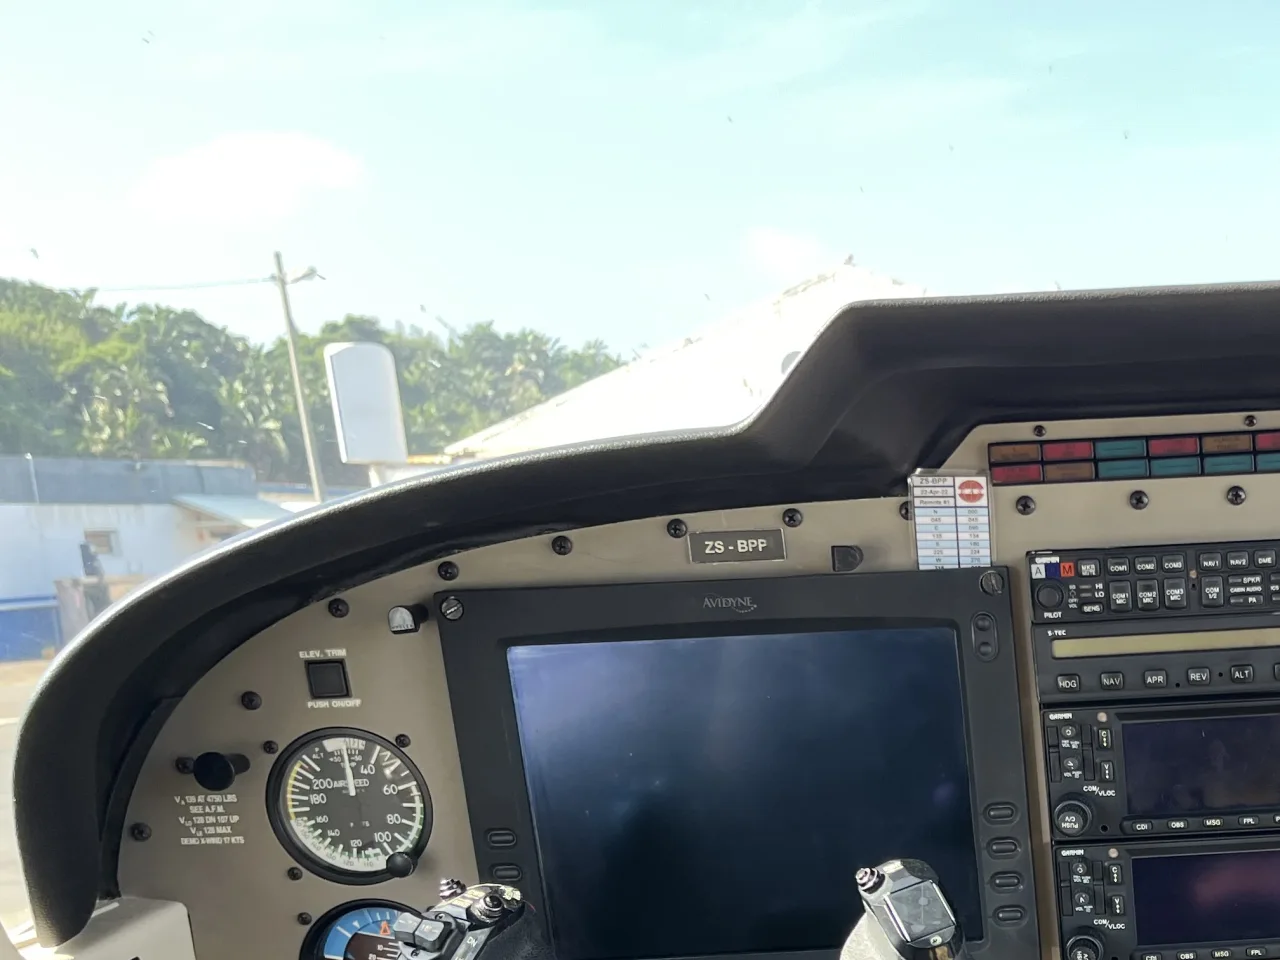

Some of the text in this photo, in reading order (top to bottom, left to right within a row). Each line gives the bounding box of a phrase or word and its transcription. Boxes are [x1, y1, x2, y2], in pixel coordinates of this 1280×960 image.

[703, 596, 755, 609] AVIDYNE
[1044, 611, 1062, 619] PILOT
[298, 648, 347, 658] ELEV. TRIM
[1190, 673, 1207, 681] REV
[1234, 670, 1249, 679] ALT
[1060, 680, 1077, 688] HDG
[1103, 677, 1120, 686] NAV
[1146, 676, 1164, 684] APR
[307, 699, 361, 709] PUSH ON/OFF
[360, 764, 376, 775] 40
[383, 784, 398, 795] 60
[310, 793, 327, 805] 180
[316, 815, 329, 824] 160
[386, 813, 401, 825] 80
[1171, 821, 1185, 829] OBS
[374, 831, 392, 843] 100
[350, 839, 362, 847] 120
[1061, 849, 1084, 857] GARMIN
